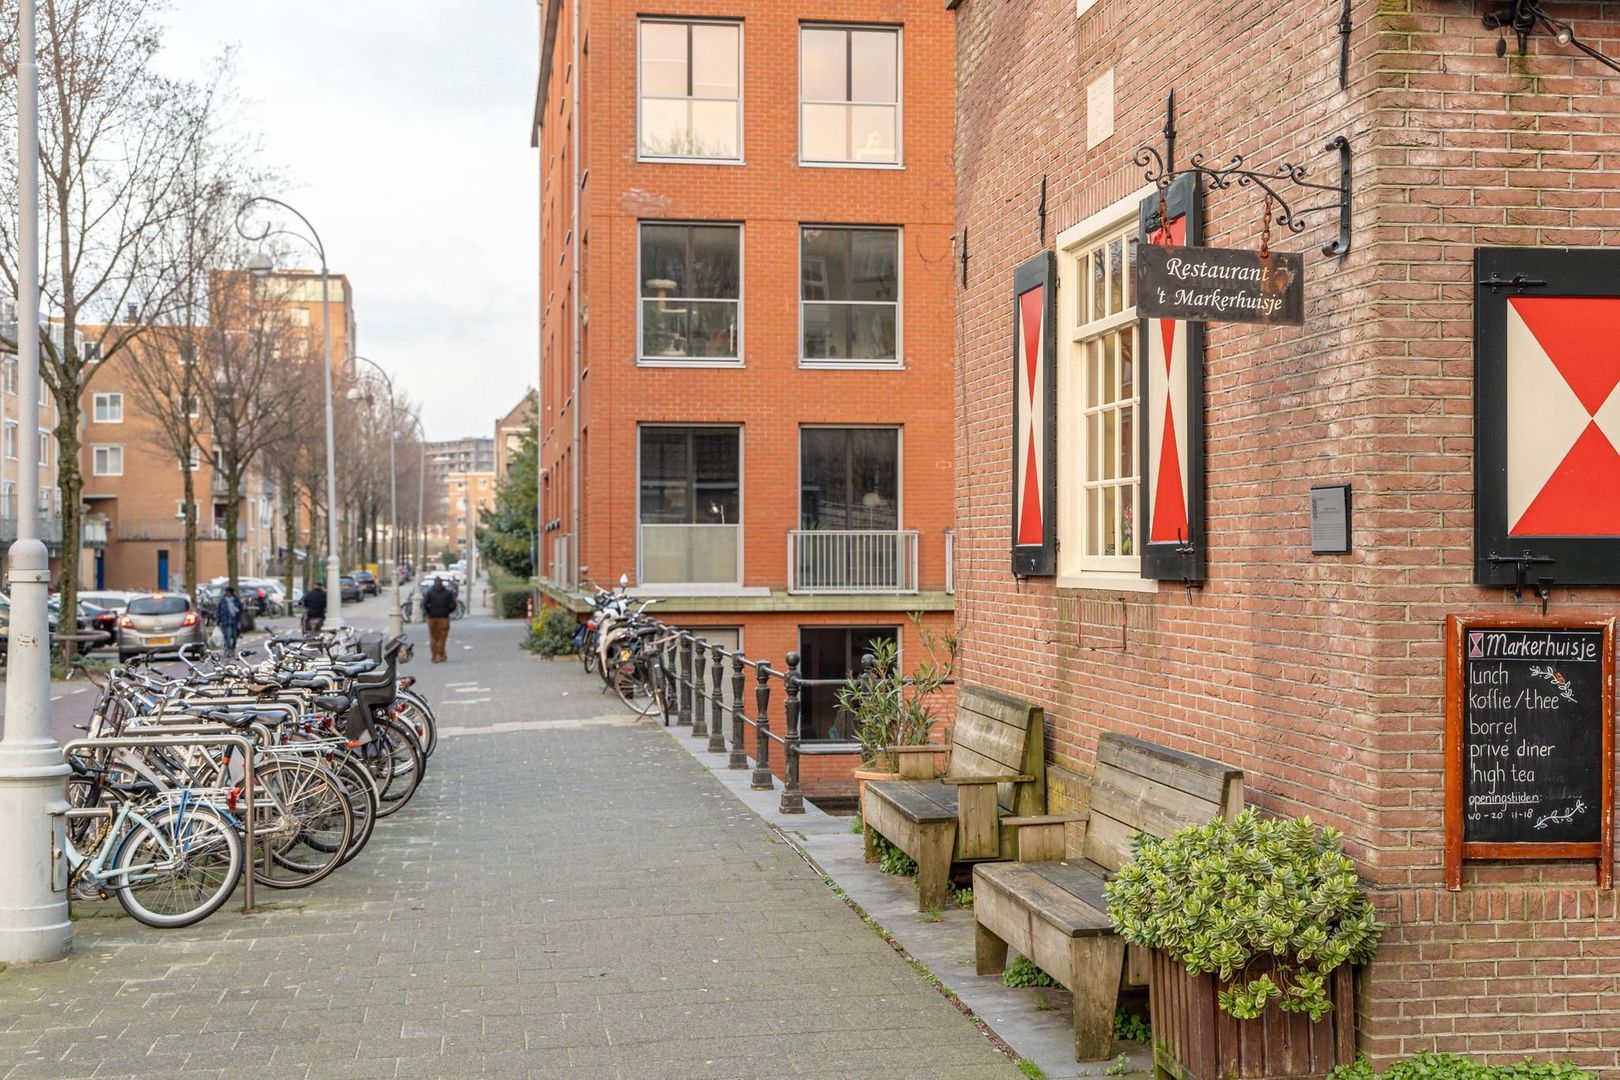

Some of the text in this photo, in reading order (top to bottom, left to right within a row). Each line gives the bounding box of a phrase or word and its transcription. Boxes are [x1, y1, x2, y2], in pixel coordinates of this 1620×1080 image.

[1166, 257, 1270, 282] Restaurant
[1156, 287, 1282, 315] 't Markerhuisje
[1487, 633, 1596, 660] Markerhuisje
[1469, 662, 1509, 685] lunch
[1469, 712, 1517, 735] borrel
[1470, 739, 1555, 768] privé diner
[1472, 761, 1535, 794] high tea
